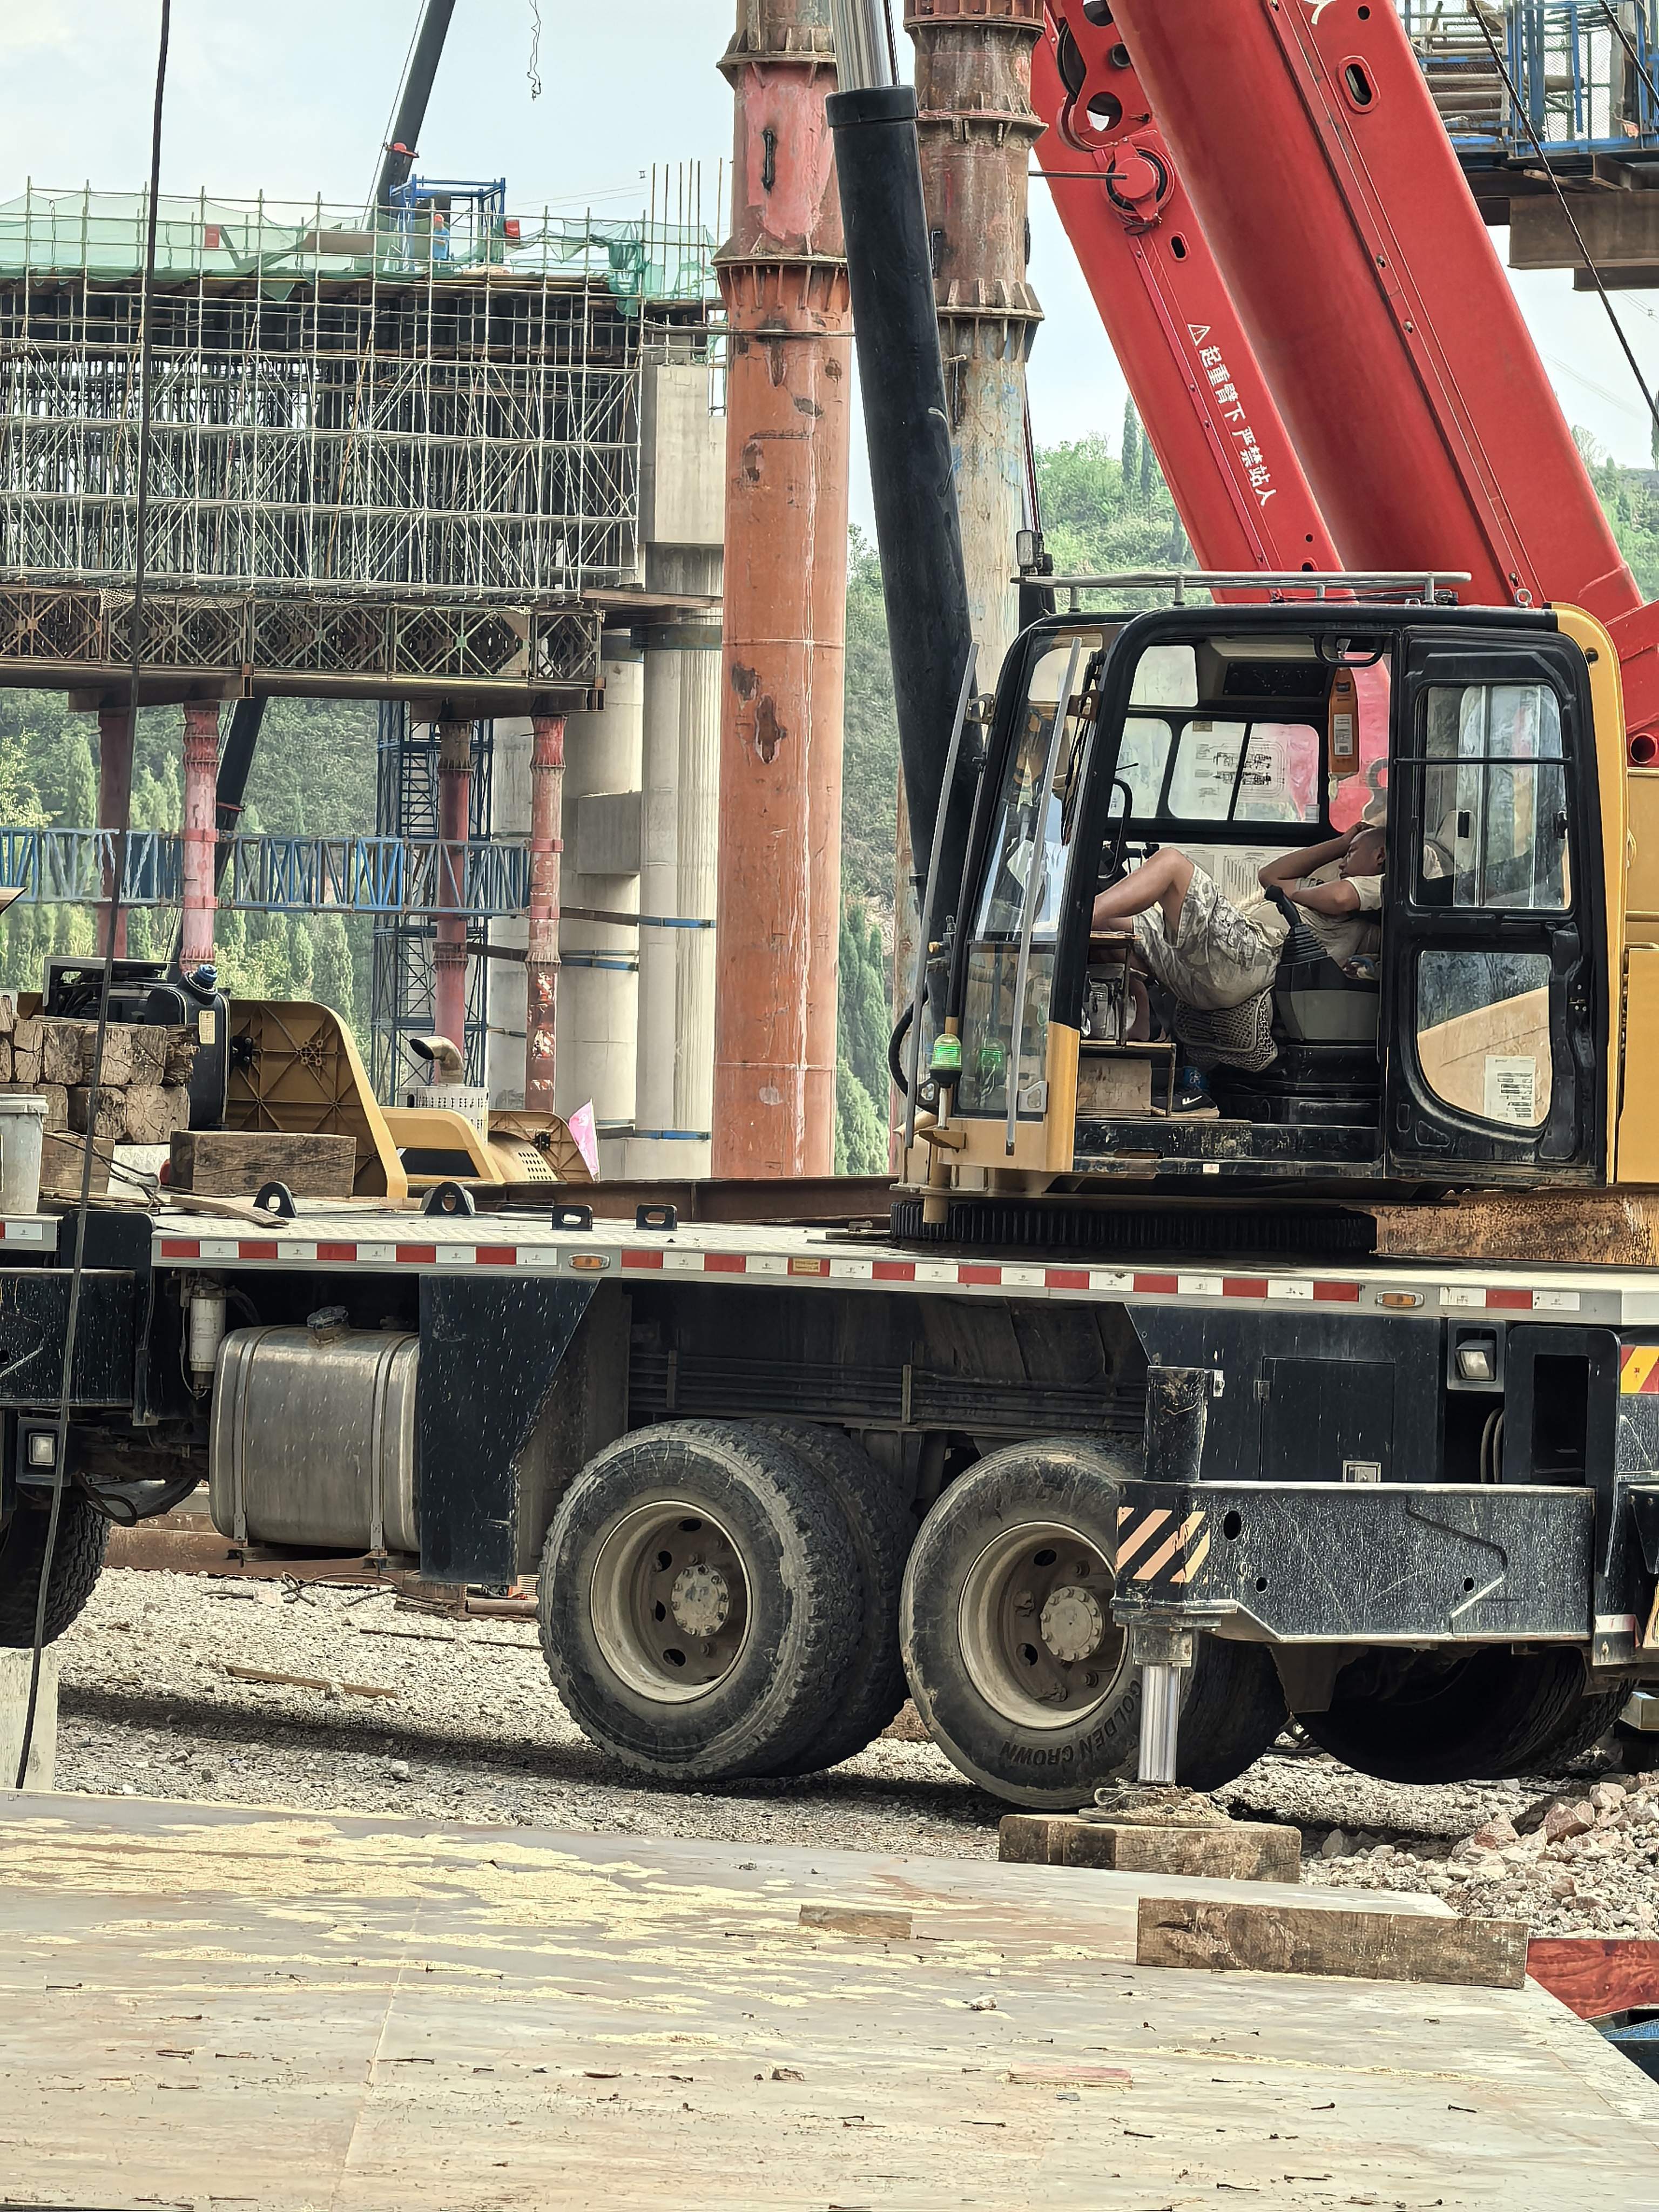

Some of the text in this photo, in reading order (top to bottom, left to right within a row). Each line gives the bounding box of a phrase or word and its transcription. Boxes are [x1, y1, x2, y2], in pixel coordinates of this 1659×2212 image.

[1199, 345, 1277, 507] 起重臂下 严禁站人
[1001, 1680, 1142, 1764] GOLDEN CROWN
